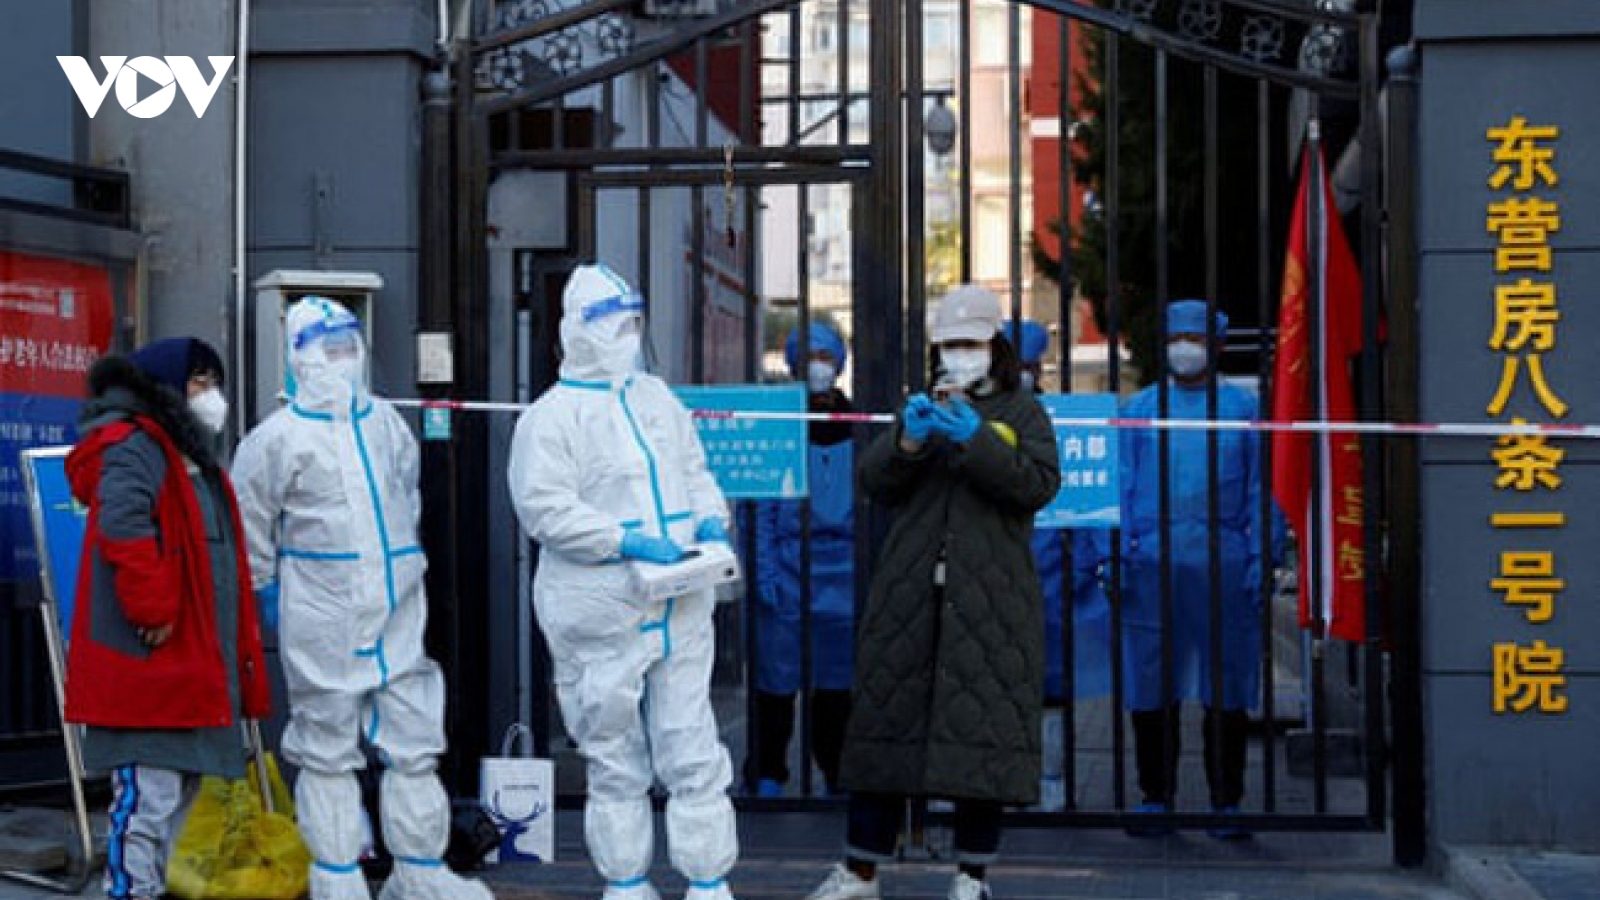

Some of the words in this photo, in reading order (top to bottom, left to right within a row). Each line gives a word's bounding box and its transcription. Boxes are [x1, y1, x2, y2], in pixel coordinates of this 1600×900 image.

[1486, 116, 1568, 714] 东营房八条一号院
